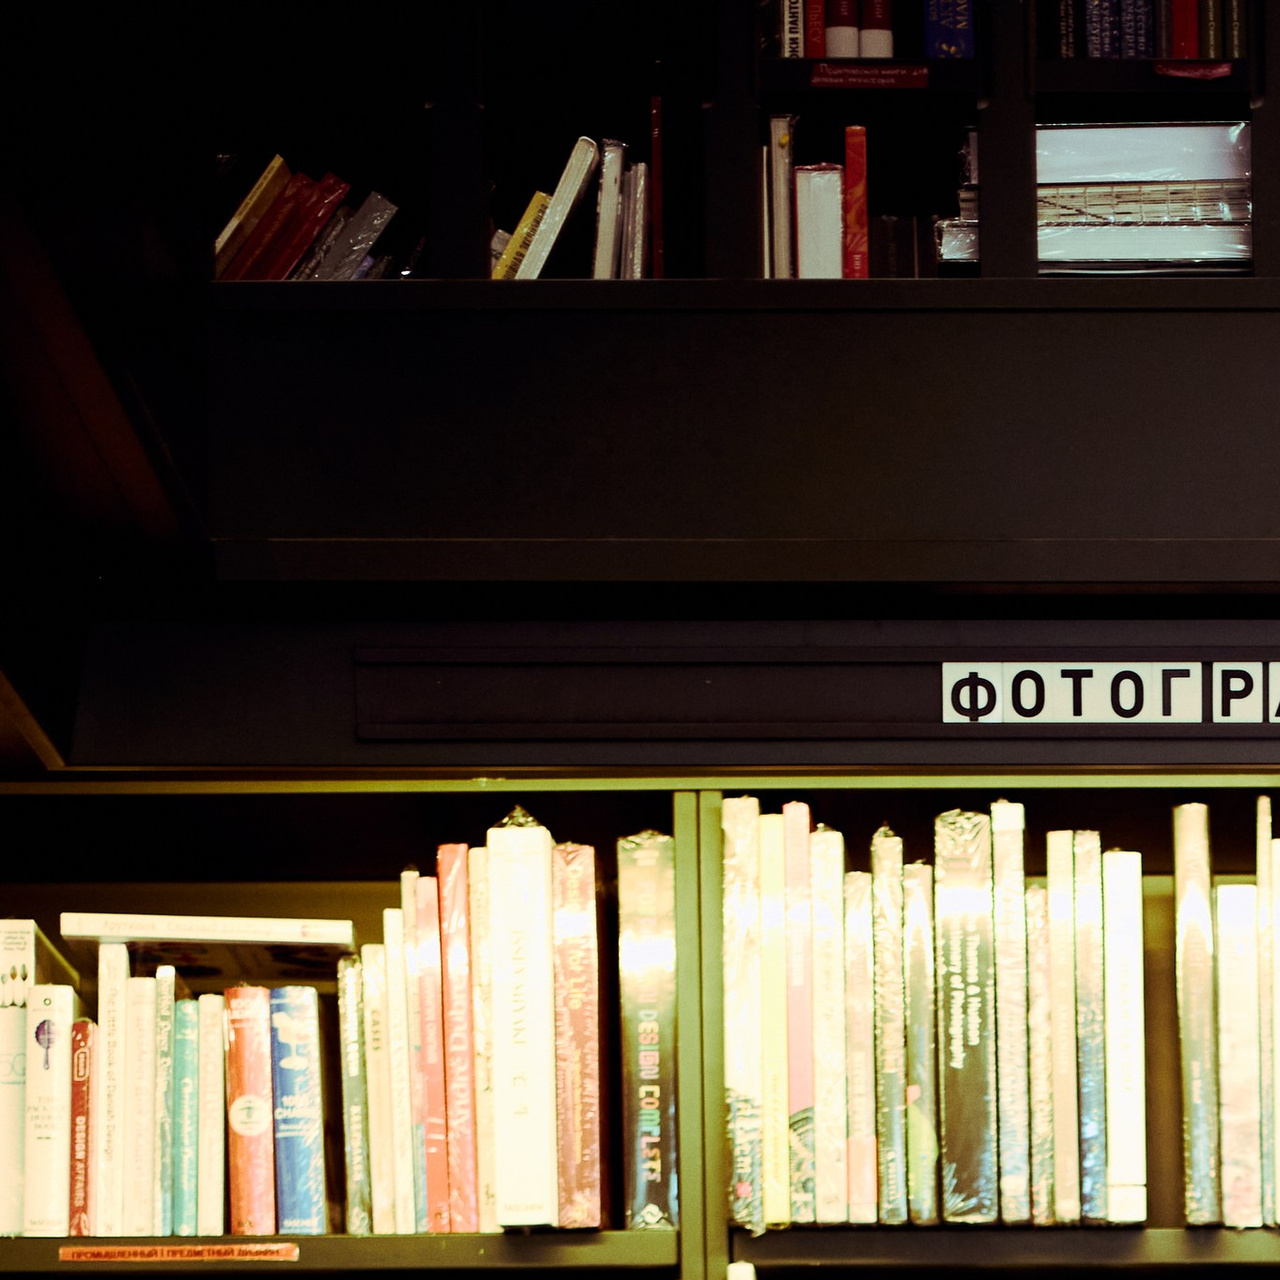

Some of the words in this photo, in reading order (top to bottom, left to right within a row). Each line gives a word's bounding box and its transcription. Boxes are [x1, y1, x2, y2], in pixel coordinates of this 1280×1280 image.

[966, 935, 979, 984] Thames
[371, 1009, 383, 1052] CASES
[638, 1008, 660, 1080] DESIGN
[948, 990, 966, 1069] Photography
[966, 998, 980, 1046] Hudson
[449, 1053, 470, 1134] André
[74, 1115, 87, 1159] DESIGN
[637, 1085, 661, 1184] COMPLETE
